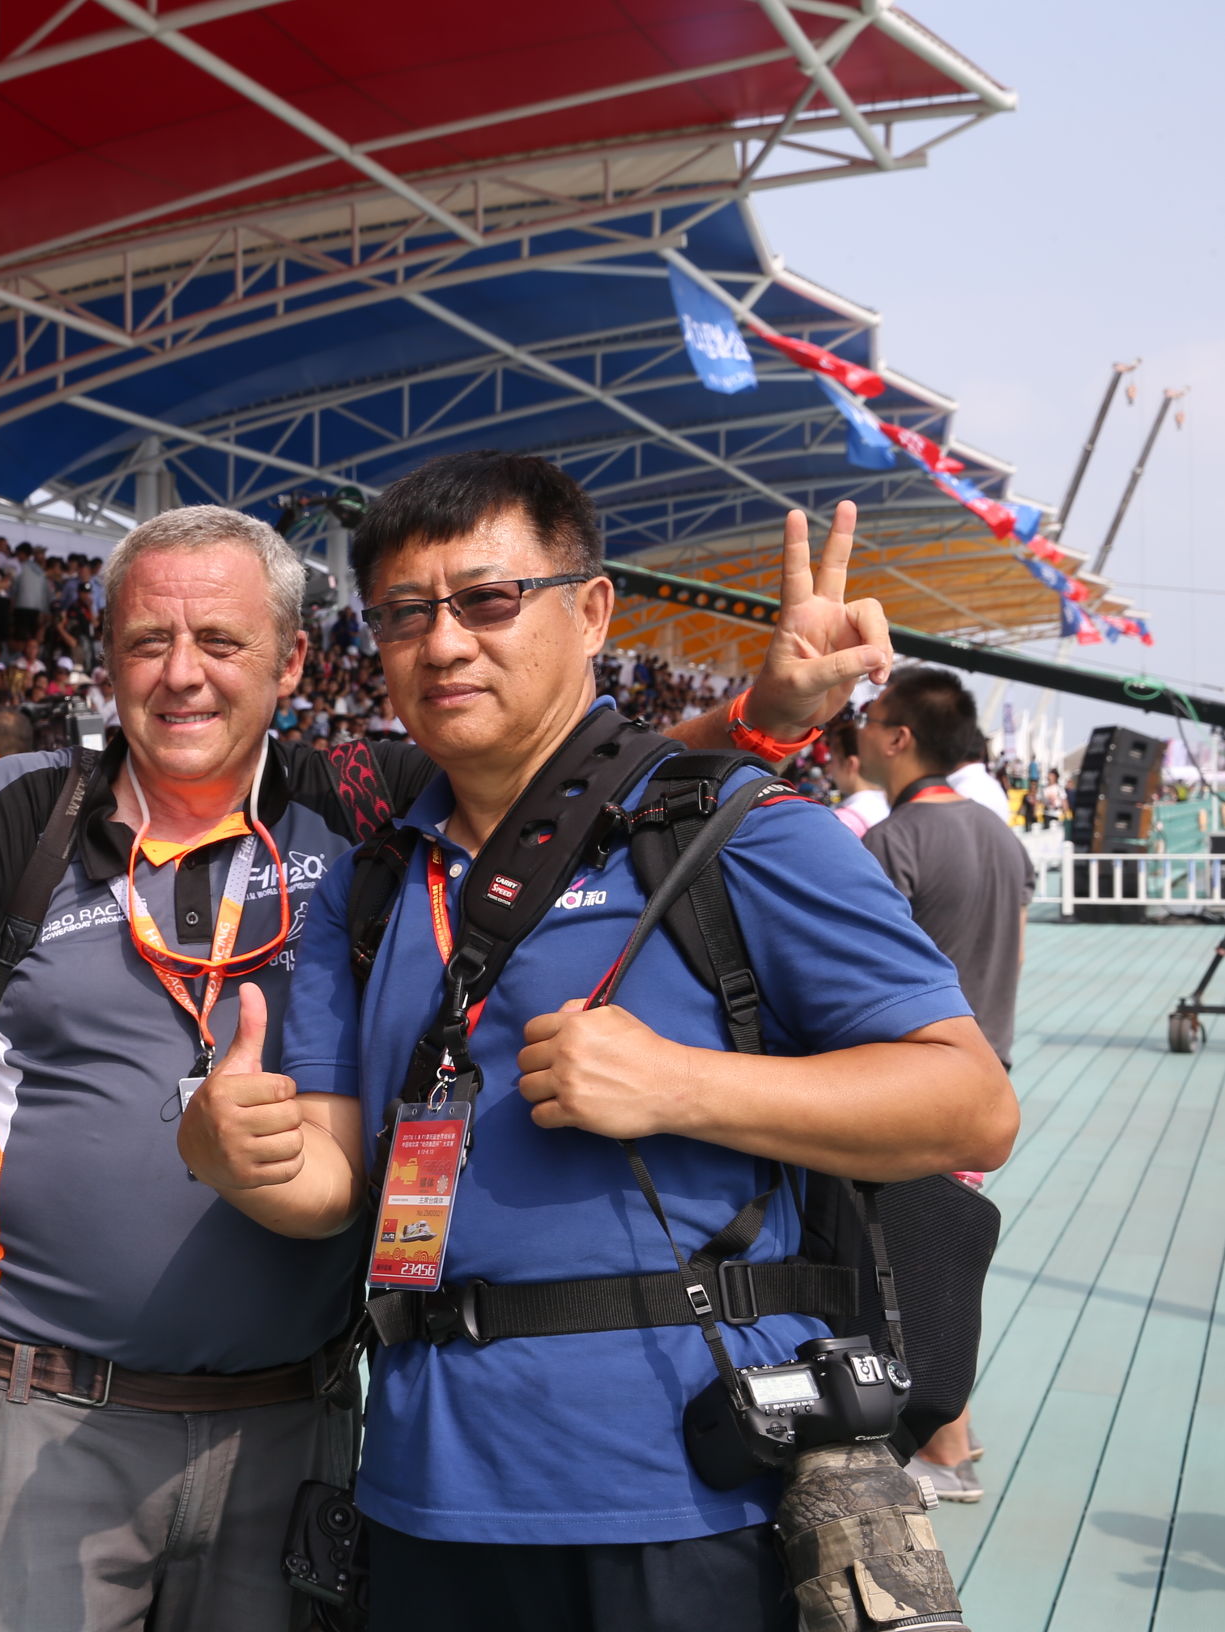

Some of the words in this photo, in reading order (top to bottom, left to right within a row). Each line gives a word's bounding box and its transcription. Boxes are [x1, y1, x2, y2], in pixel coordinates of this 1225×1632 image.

[495, 876, 518, 889] CARRY
[41, 914, 75, 936] H2O
[41, 920, 92, 943] POWERBOAT
[400, 1262, 436, 1277] 23456
